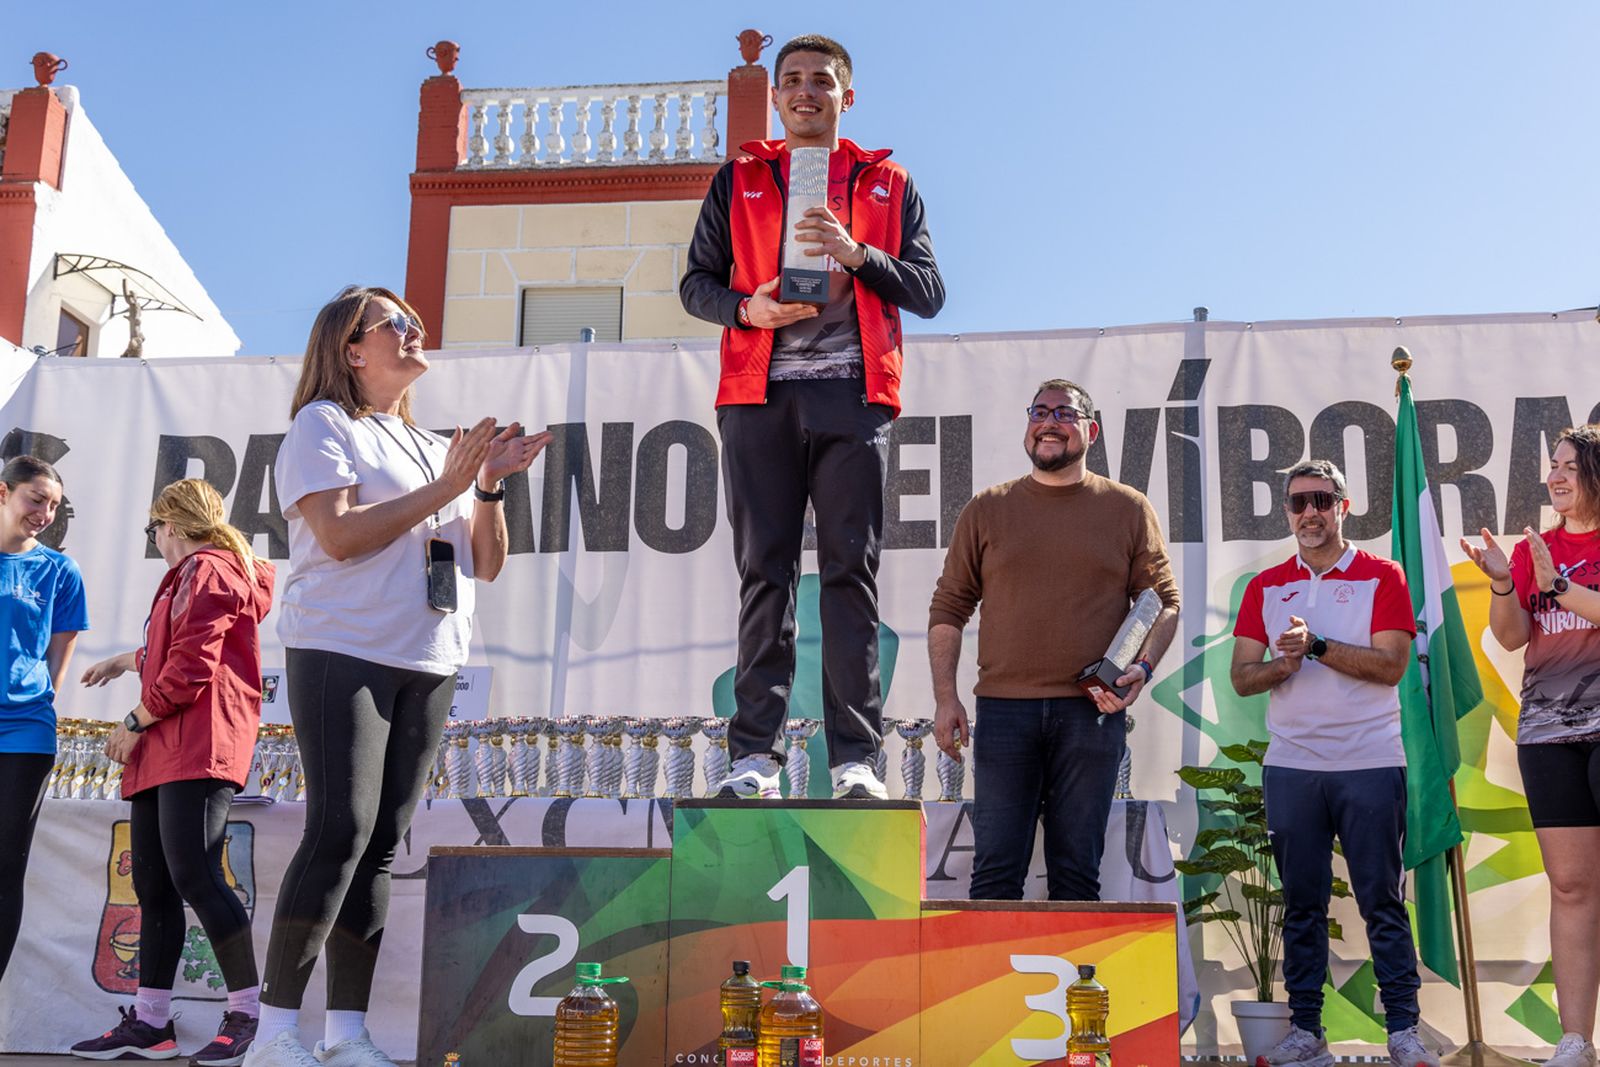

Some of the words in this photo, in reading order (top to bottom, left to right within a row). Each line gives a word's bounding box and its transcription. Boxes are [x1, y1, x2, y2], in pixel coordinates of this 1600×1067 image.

[508, 914, 580, 1016] 2
[766, 865, 810, 969] 1
[1009, 954, 1081, 1061] 3
[825, 1056, 913, 1067] DEPORTES
